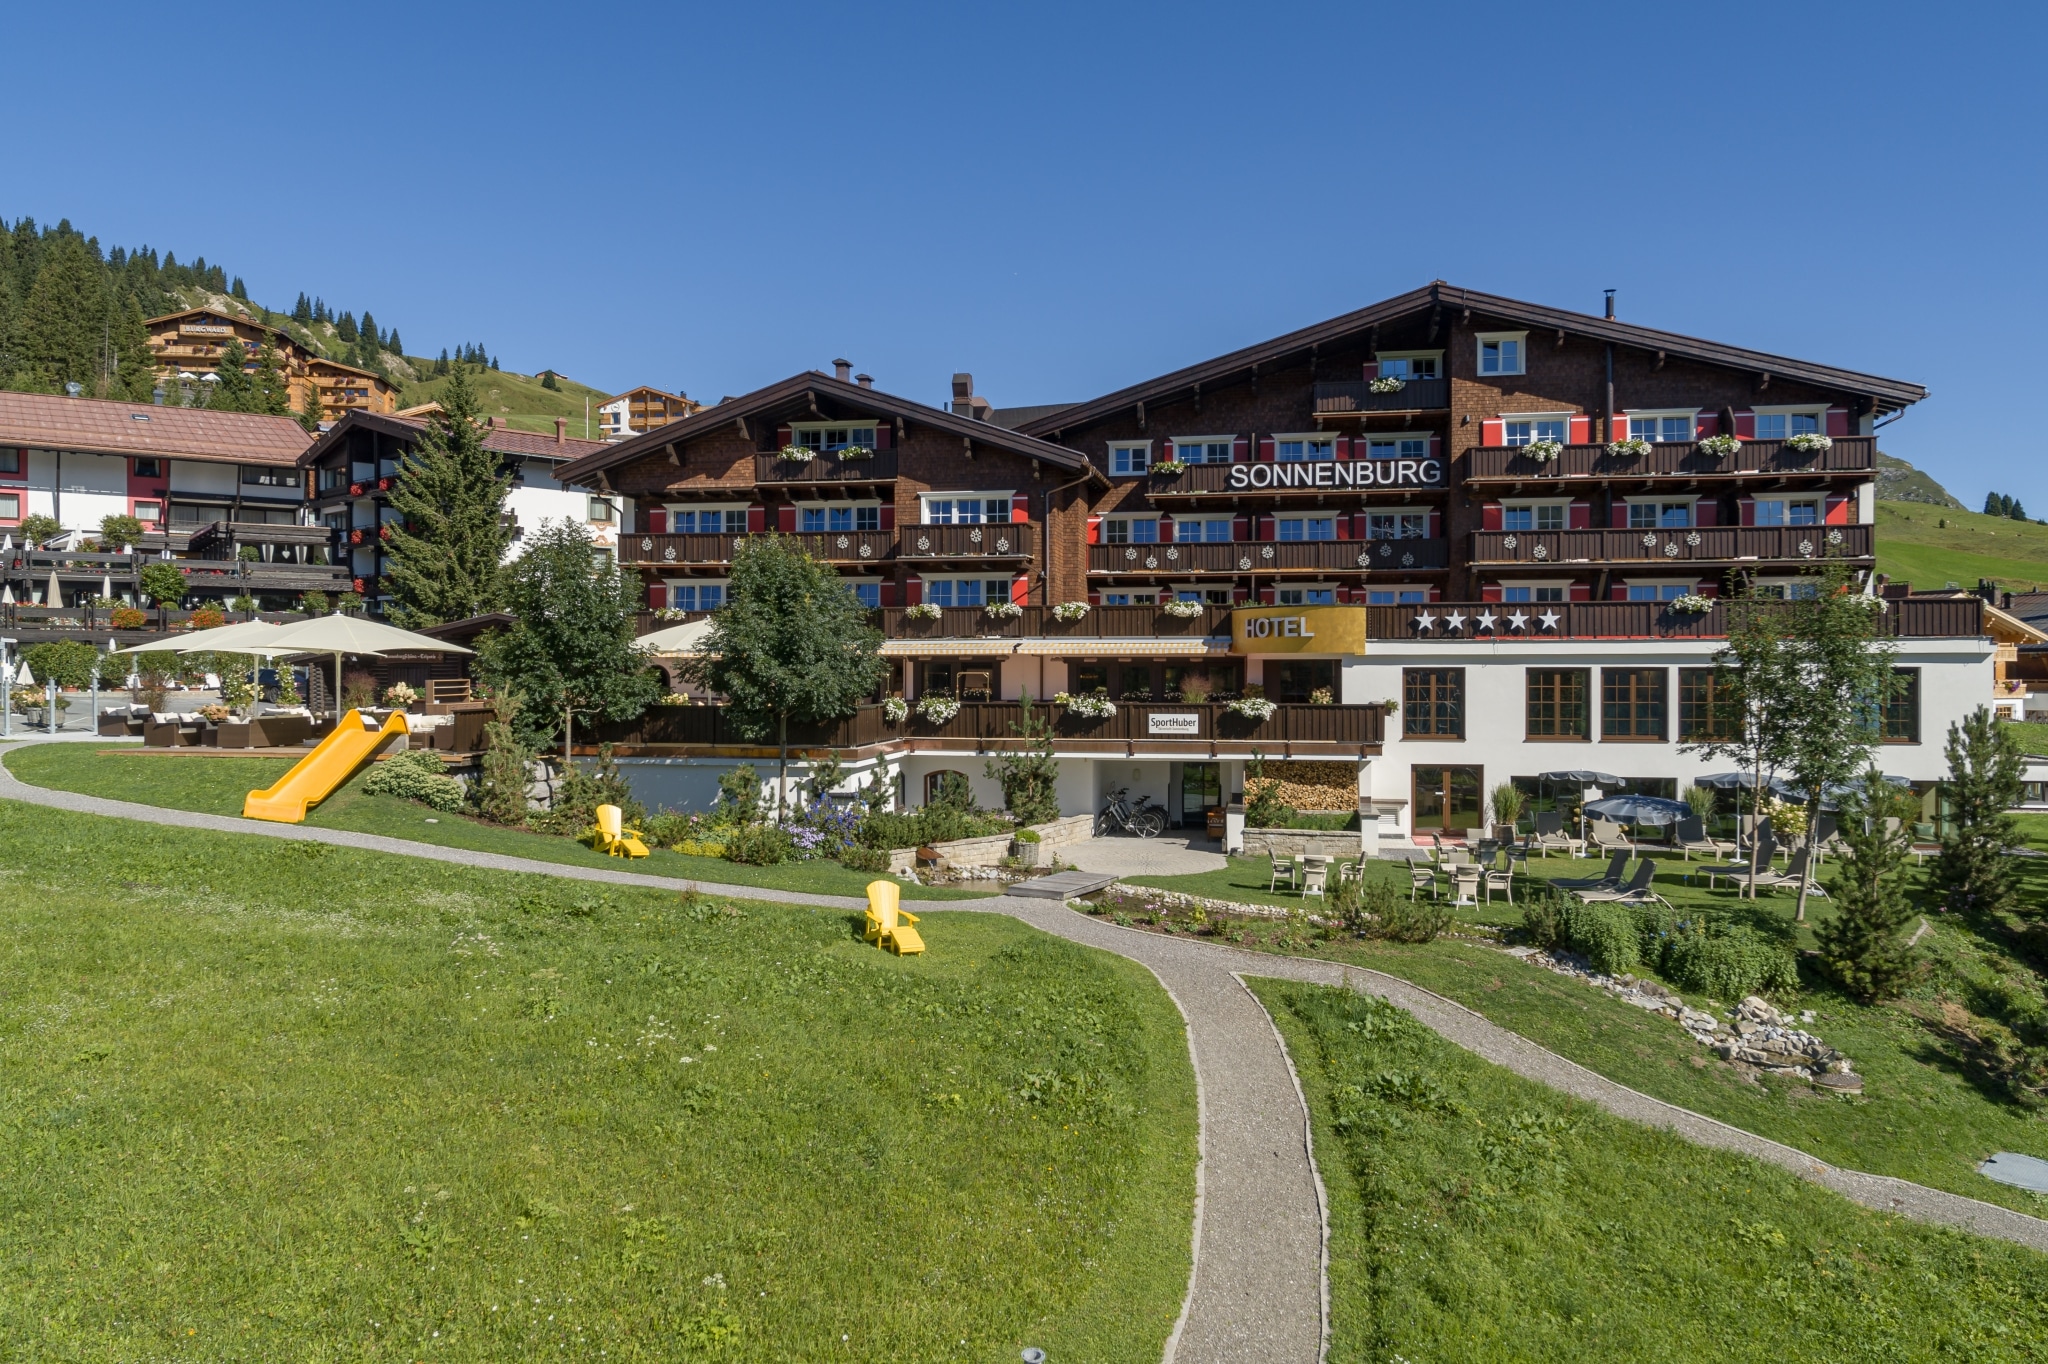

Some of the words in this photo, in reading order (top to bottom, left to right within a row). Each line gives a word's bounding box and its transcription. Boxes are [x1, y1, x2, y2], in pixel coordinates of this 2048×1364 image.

[1230, 459, 1441, 488] SONNENBURG
[1245, 616, 1315, 638] HOTEL
[1151, 717, 1196, 728] SportHuber
